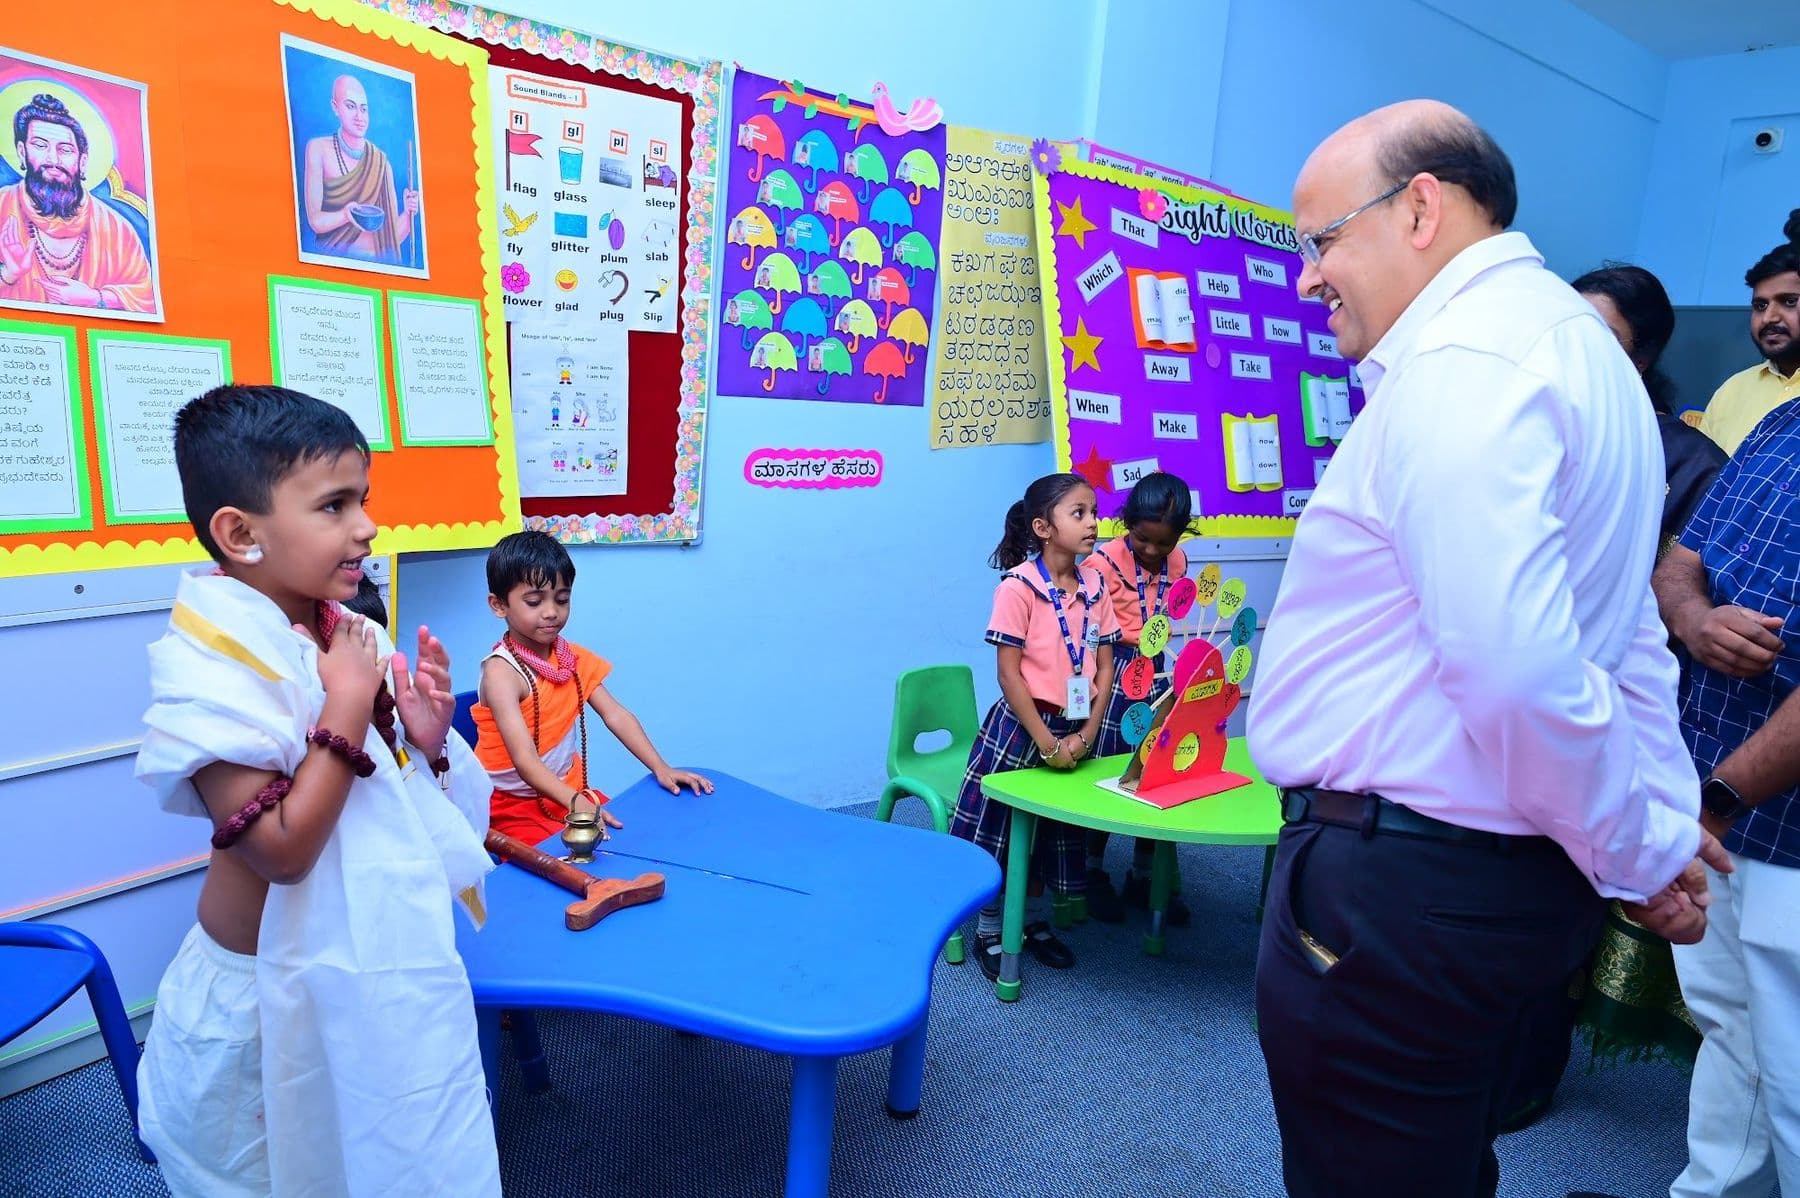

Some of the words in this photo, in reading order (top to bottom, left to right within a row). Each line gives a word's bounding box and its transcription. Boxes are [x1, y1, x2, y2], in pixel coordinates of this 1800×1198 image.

[513, 83, 538, 95] Sound
[514, 114, 523, 125] fl
[567, 126, 580, 137] gl
[613, 135, 624, 148] pl
[653, 145, 663, 156] sl
[1110, 161, 1133, 173] words
[1161, 175, 1183, 186] words
[513, 182, 537, 197] flag
[554, 189, 588, 204] glass
[645, 198, 676, 210] sleep
[1121, 217, 1145, 238] That
[1235, 210, 1298, 248] Words
[507, 242, 524, 256] fly
[551, 240, 590, 254] glitter
[600, 253, 628, 265] plum
[645, 251, 669, 262] slab
[1083, 263, 1114, 291] Which
[1253, 263, 1273, 278] Who
[1207, 278, 1230, 295] Help
[502, 294, 543, 308] flower
[555, 301, 579, 314] glad
[600, 309, 624, 322] plug
[643, 311, 663, 322] Slip
[1215, 316, 1240, 331] Little
[1272, 324, 1290, 337] how
[1319, 339, 1332, 352] See
[1151, 362, 1179, 378] Away
[1239, 359, 1262, 374] Take
[1075, 398, 1109, 414] When
[1159, 419, 1187, 433] Make
[754, 459, 827, 478] ಮಾಸಗಳ
[831, 458, 876, 476] ಹೆಸರು
[1123, 467, 1142, 482] Sad
